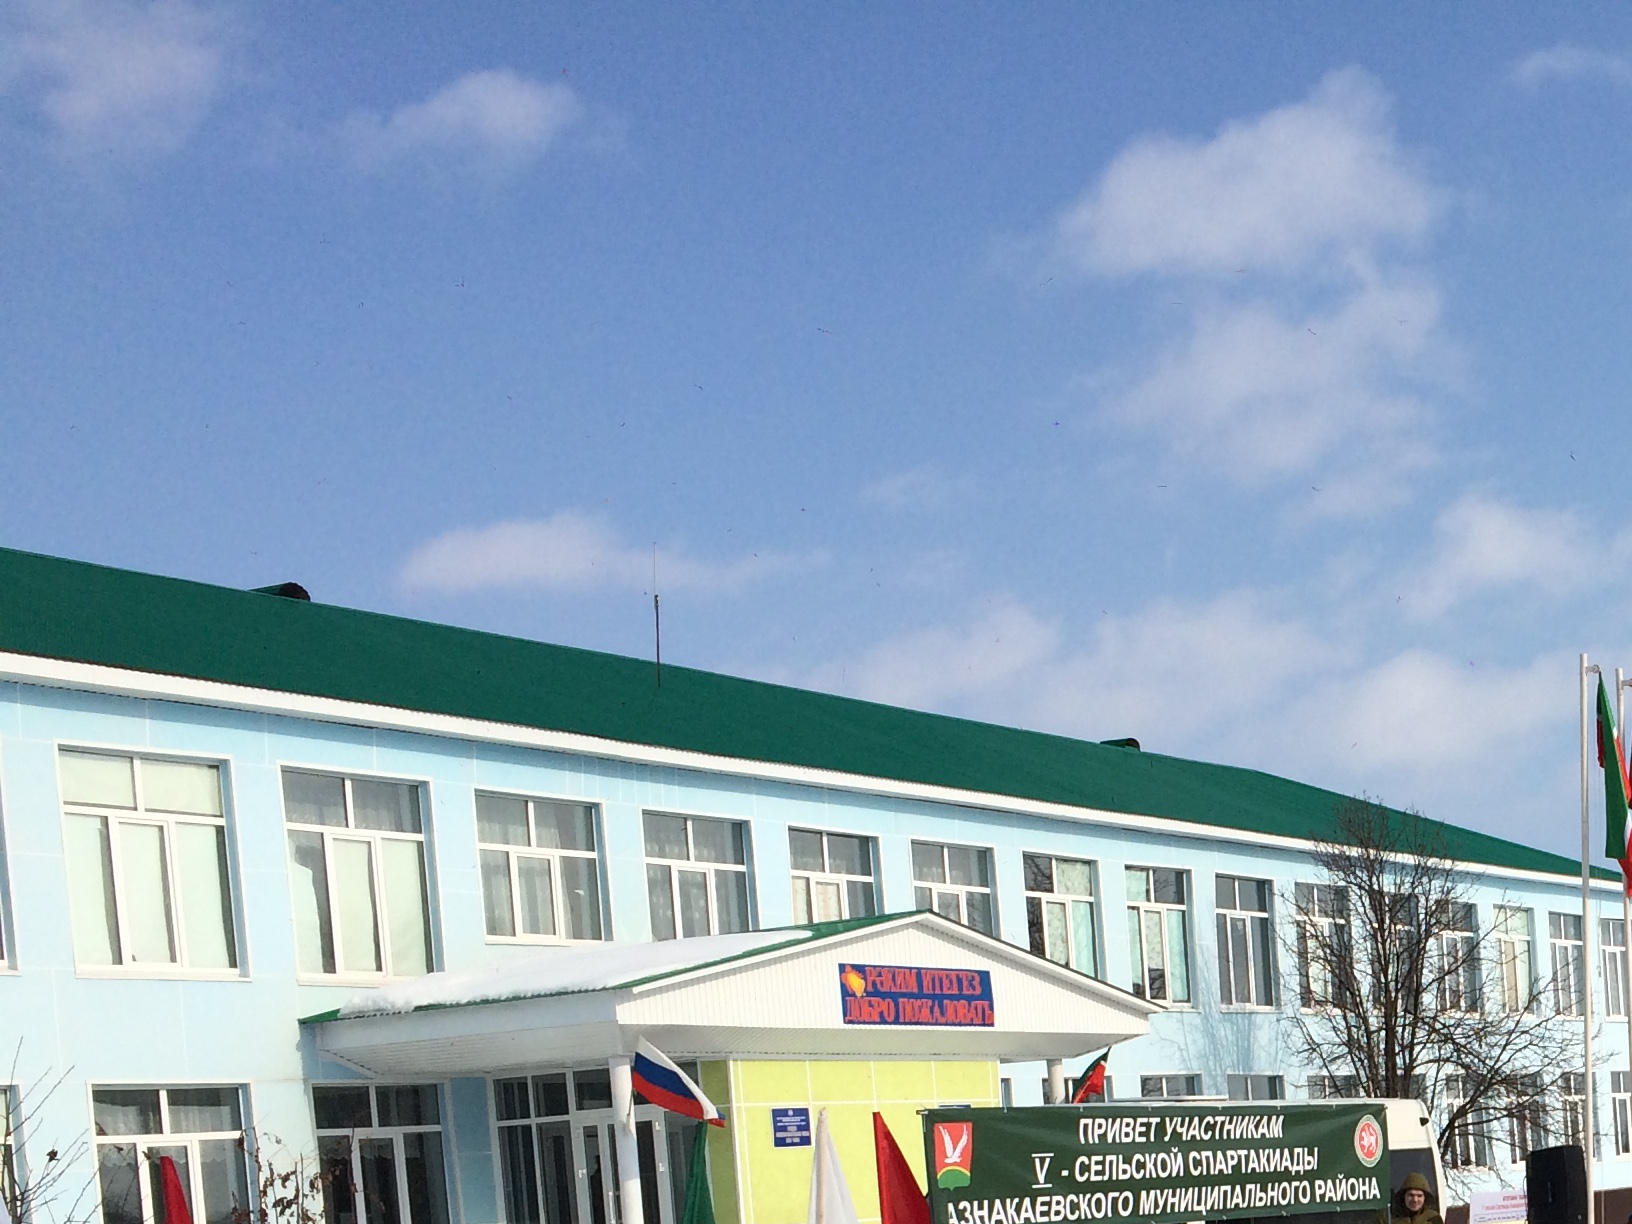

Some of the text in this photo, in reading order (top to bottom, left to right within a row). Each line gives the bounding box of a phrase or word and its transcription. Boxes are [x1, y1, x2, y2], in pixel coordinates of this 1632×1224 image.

[920, 970, 982, 996] ИТЕГЕЗ
[844, 996, 995, 1025] ДОБРО ПОЖАЛОВАТЬ
[1078, 1114, 1285, 1145] ПРИВЕТ УЧАСТНИКАМ
[1032, 1153, 1054, 1188] V
[1074, 1147, 1185, 1183] СЕЛЬСКОЙ
[1188, 1146, 1319, 1177] СПАРТАКИАДЫ
[1138, 1179, 1311, 1216] МУНИЦИПАЛЬНОГО
[1314, 1173, 1381, 1203] РАЙОНА
